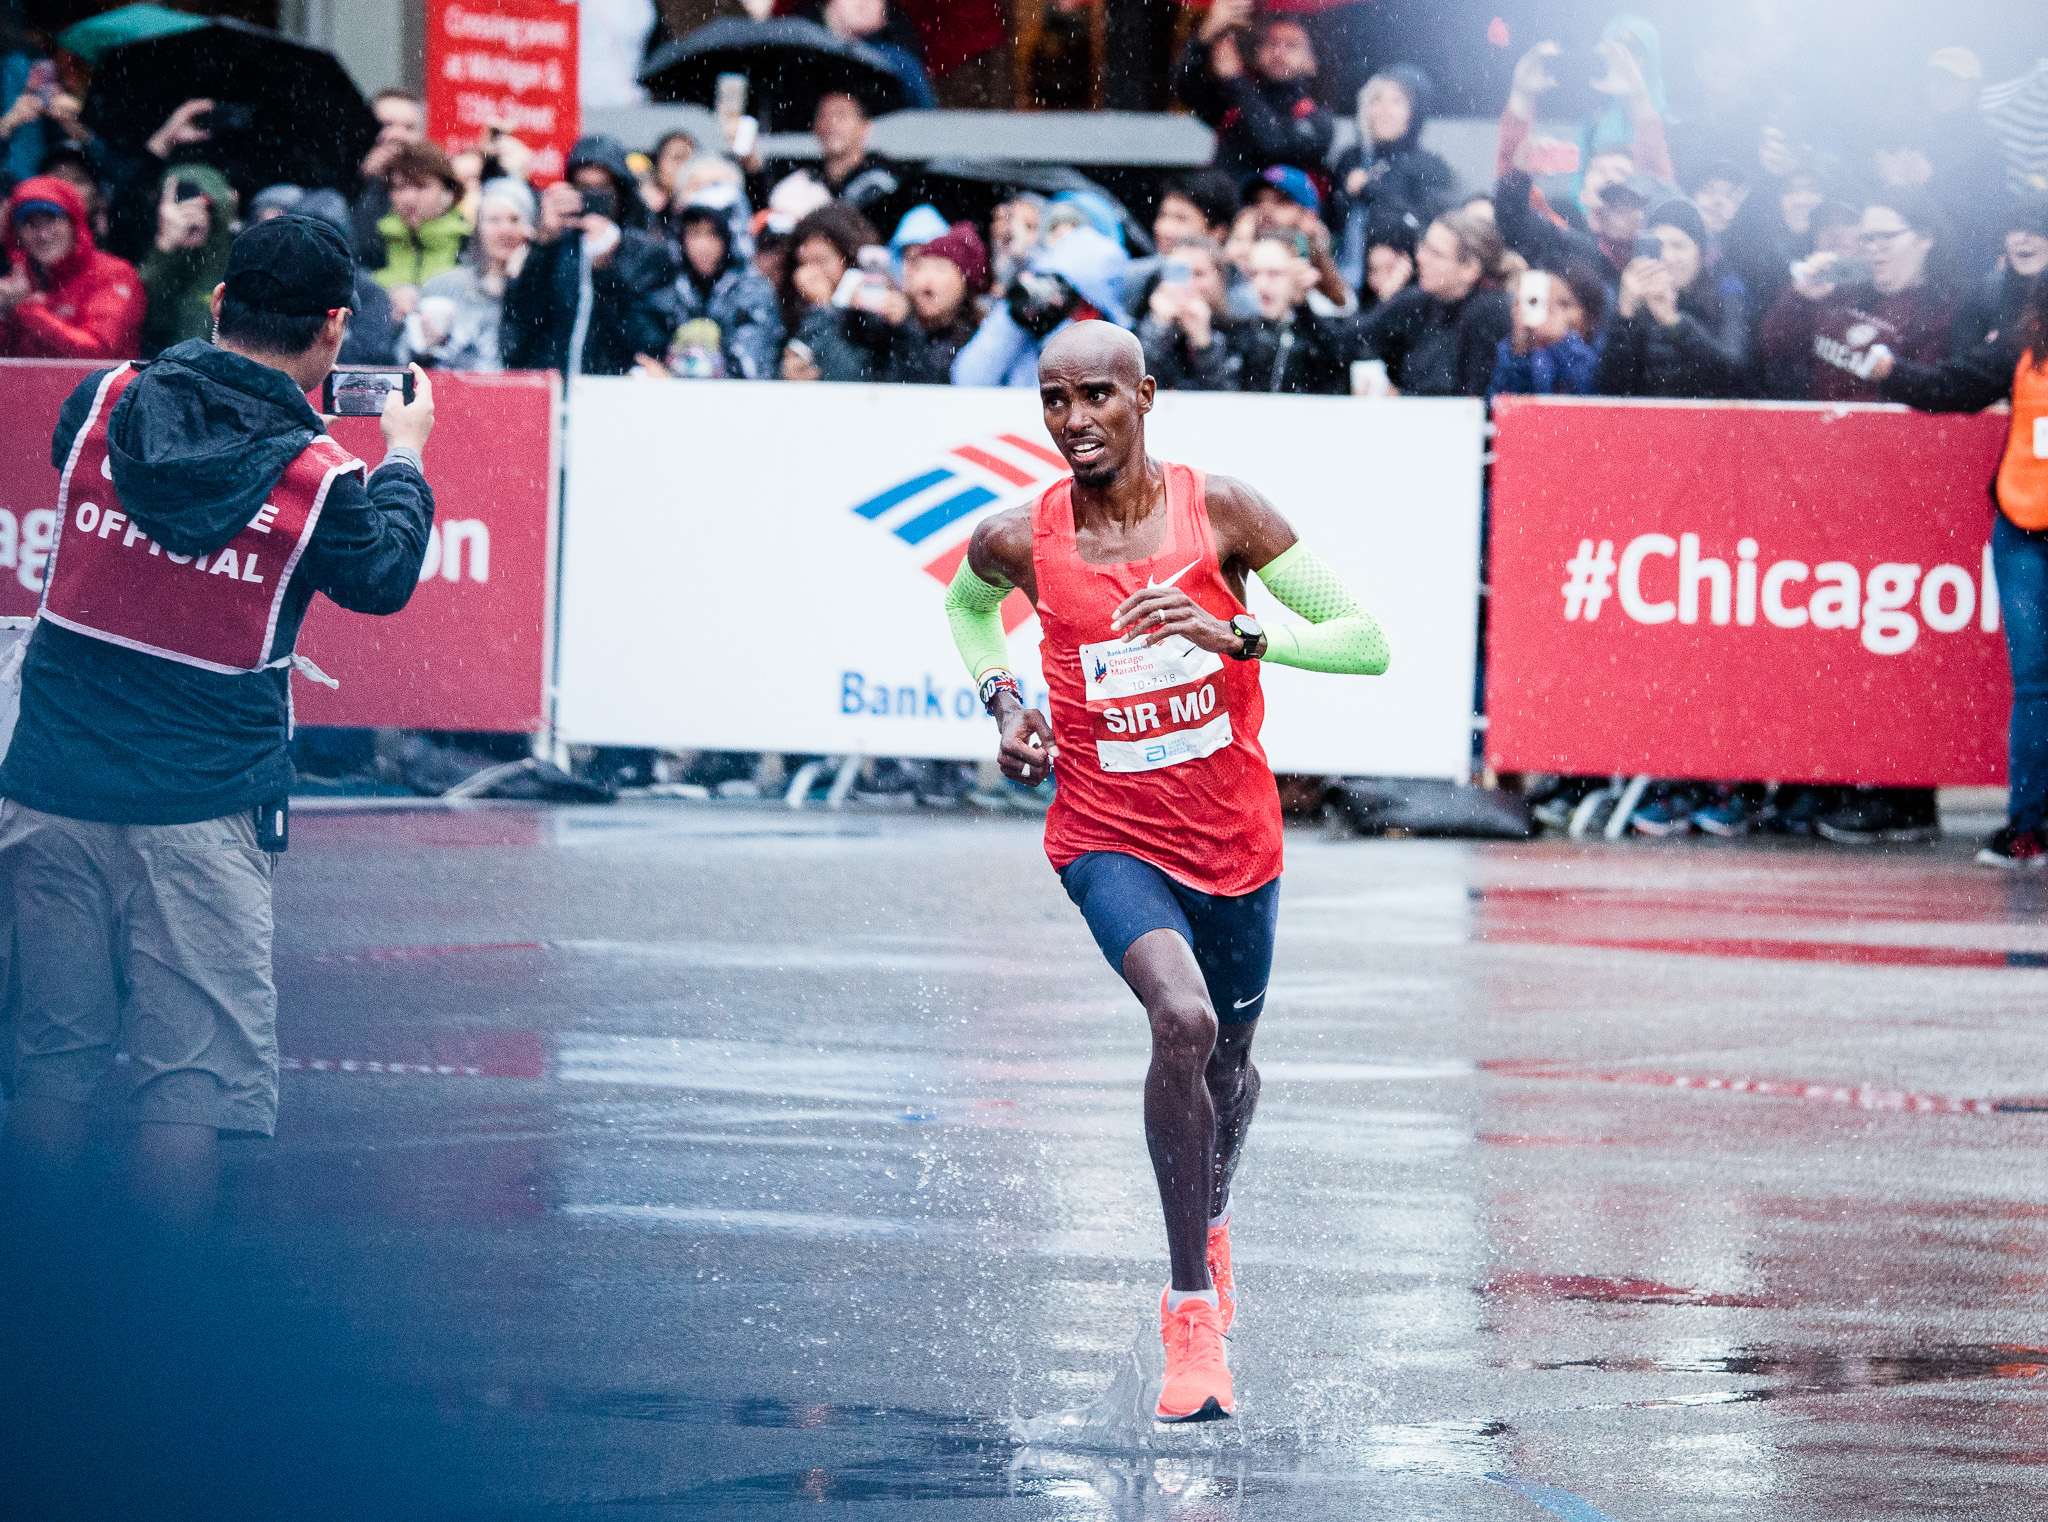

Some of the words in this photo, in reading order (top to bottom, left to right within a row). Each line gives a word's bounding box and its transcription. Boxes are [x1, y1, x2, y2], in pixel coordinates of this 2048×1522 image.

[1561, 531, 2000, 655] #Chicago
[1109, 655, 1144, 667] Chicago
[1110, 662, 1154, 676] Marathon
[841, 671, 944, 718] Bank
[1102, 702, 1161, 734] SIR
[1168, 683, 1216, 724] MO
